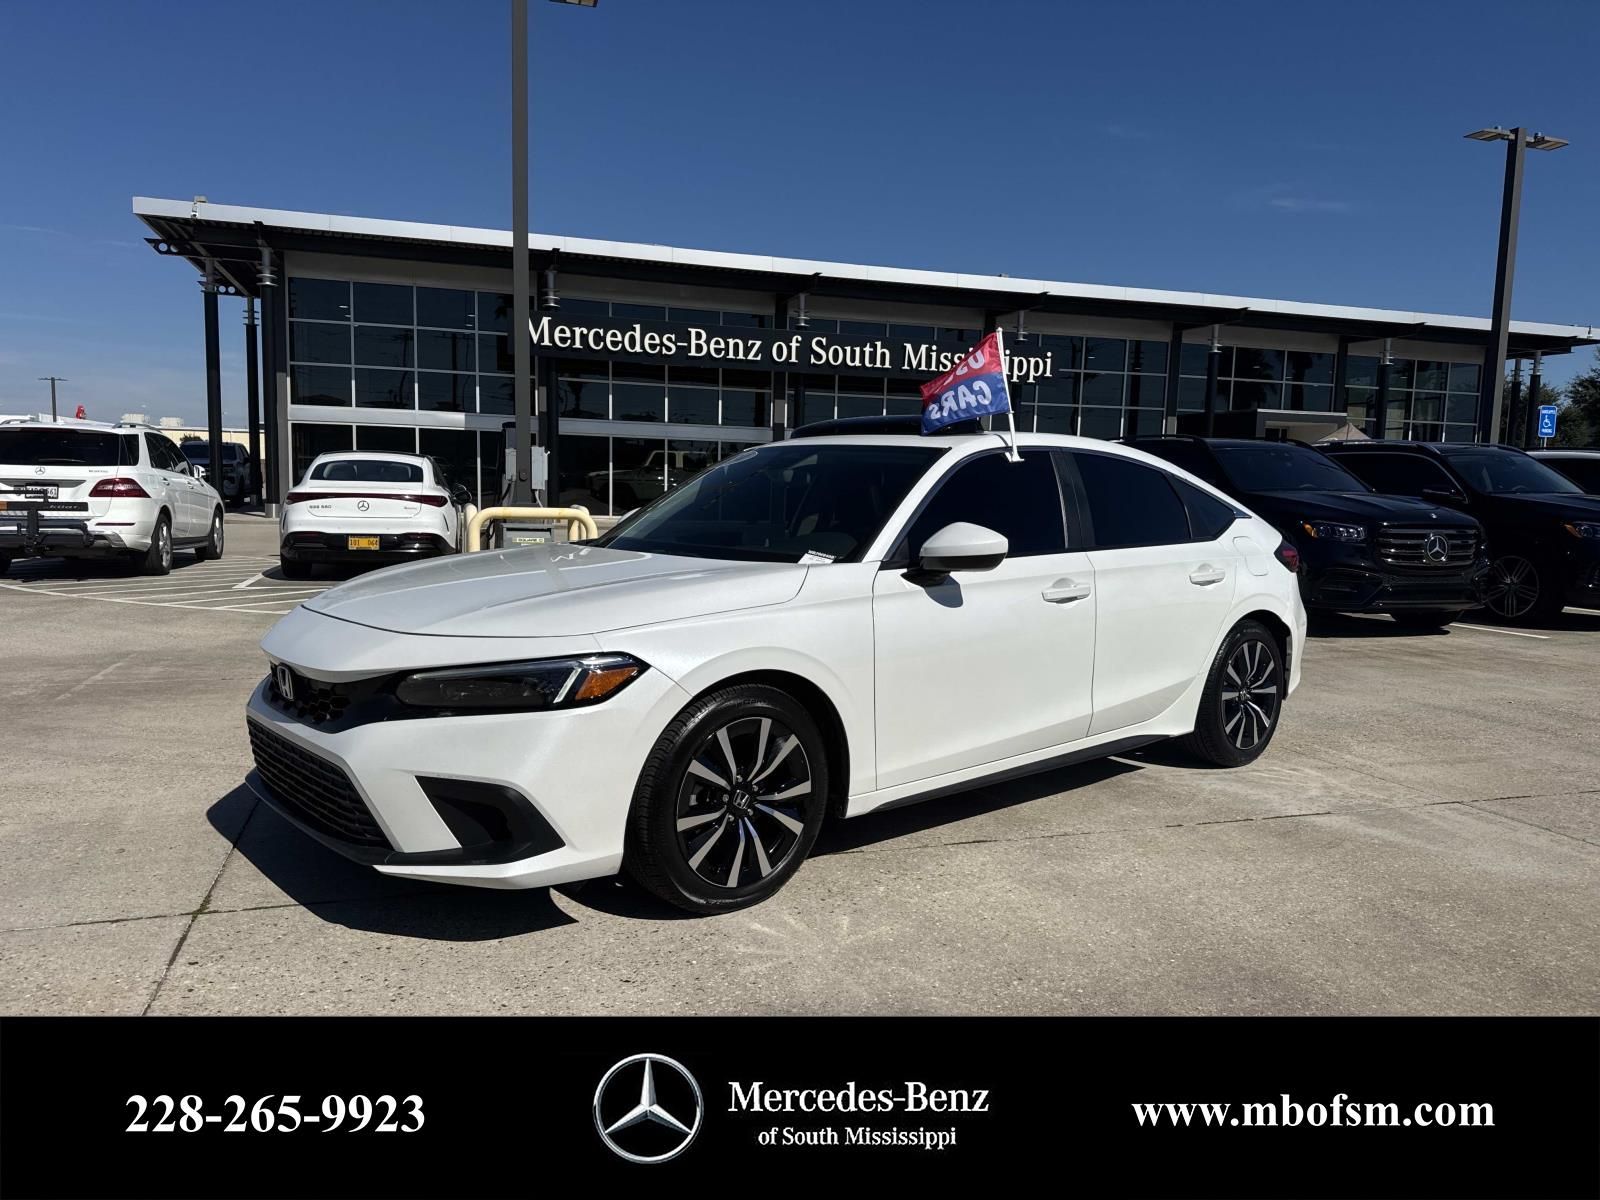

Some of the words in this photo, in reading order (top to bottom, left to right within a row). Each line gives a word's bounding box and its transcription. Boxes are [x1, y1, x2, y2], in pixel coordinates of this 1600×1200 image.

[529, 316, 762, 361] Mercedes-Benz
[771, 335, 802, 363] of
[810, 336, 892, 369] South
